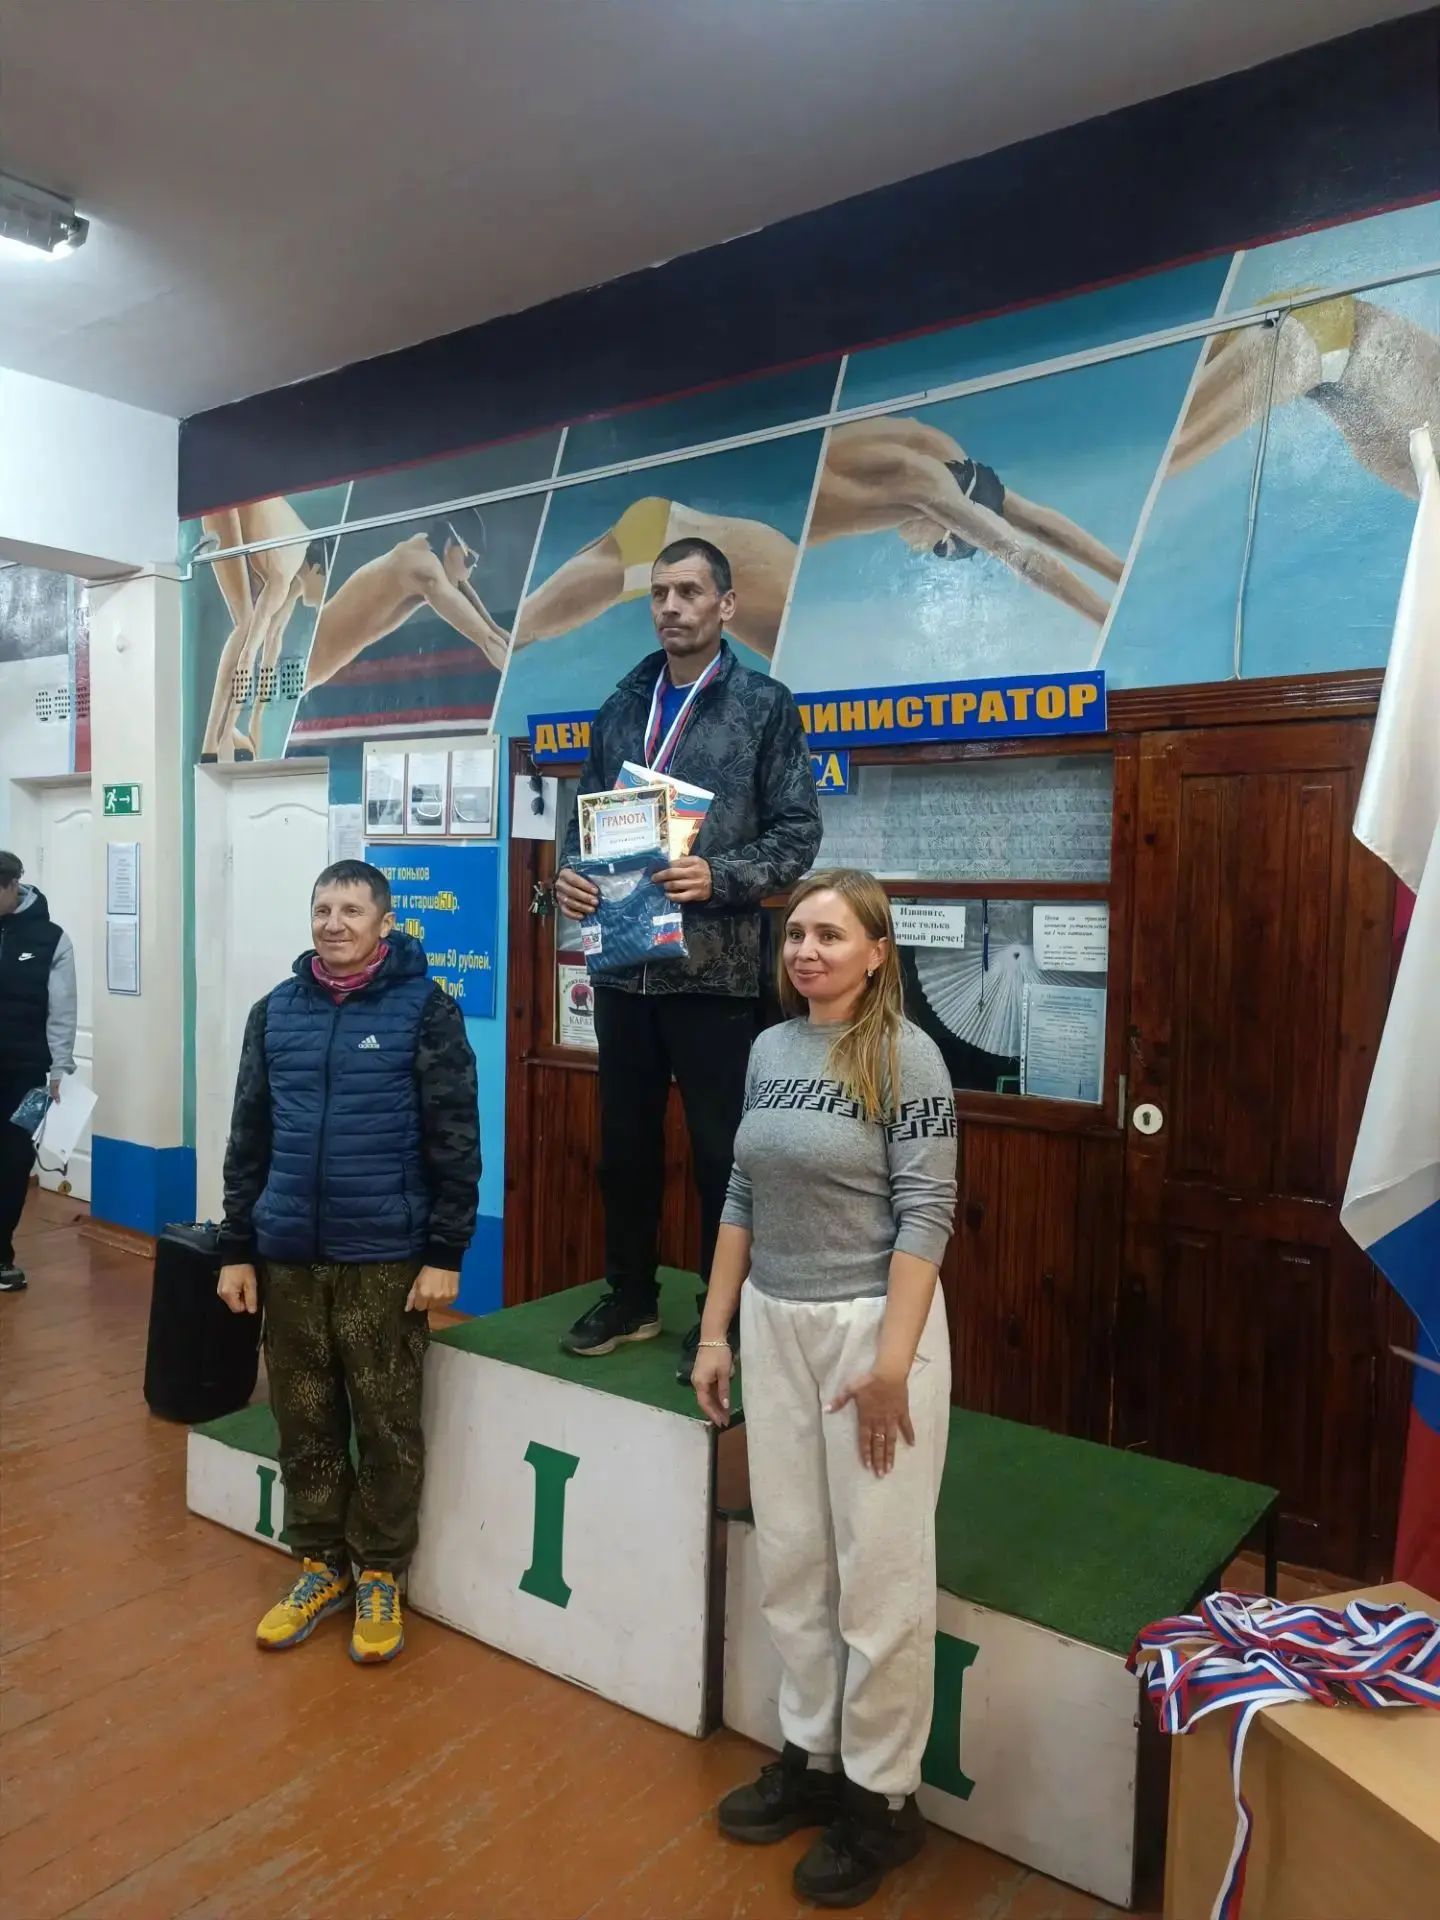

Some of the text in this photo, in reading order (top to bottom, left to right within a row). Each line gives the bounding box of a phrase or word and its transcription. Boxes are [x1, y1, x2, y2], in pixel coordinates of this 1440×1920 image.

[798, 684, 1097, 734] ИНИСТРАТОР
[534, 721, 591, 754] ДЕЖ
[601, 812, 648, 827] ГРАМОТА
[398, 866, 430, 881] коньков
[896, 932, 926, 941] ичный
[447, 948, 457, 969] 50
[459, 950, 491, 973] рублей.
